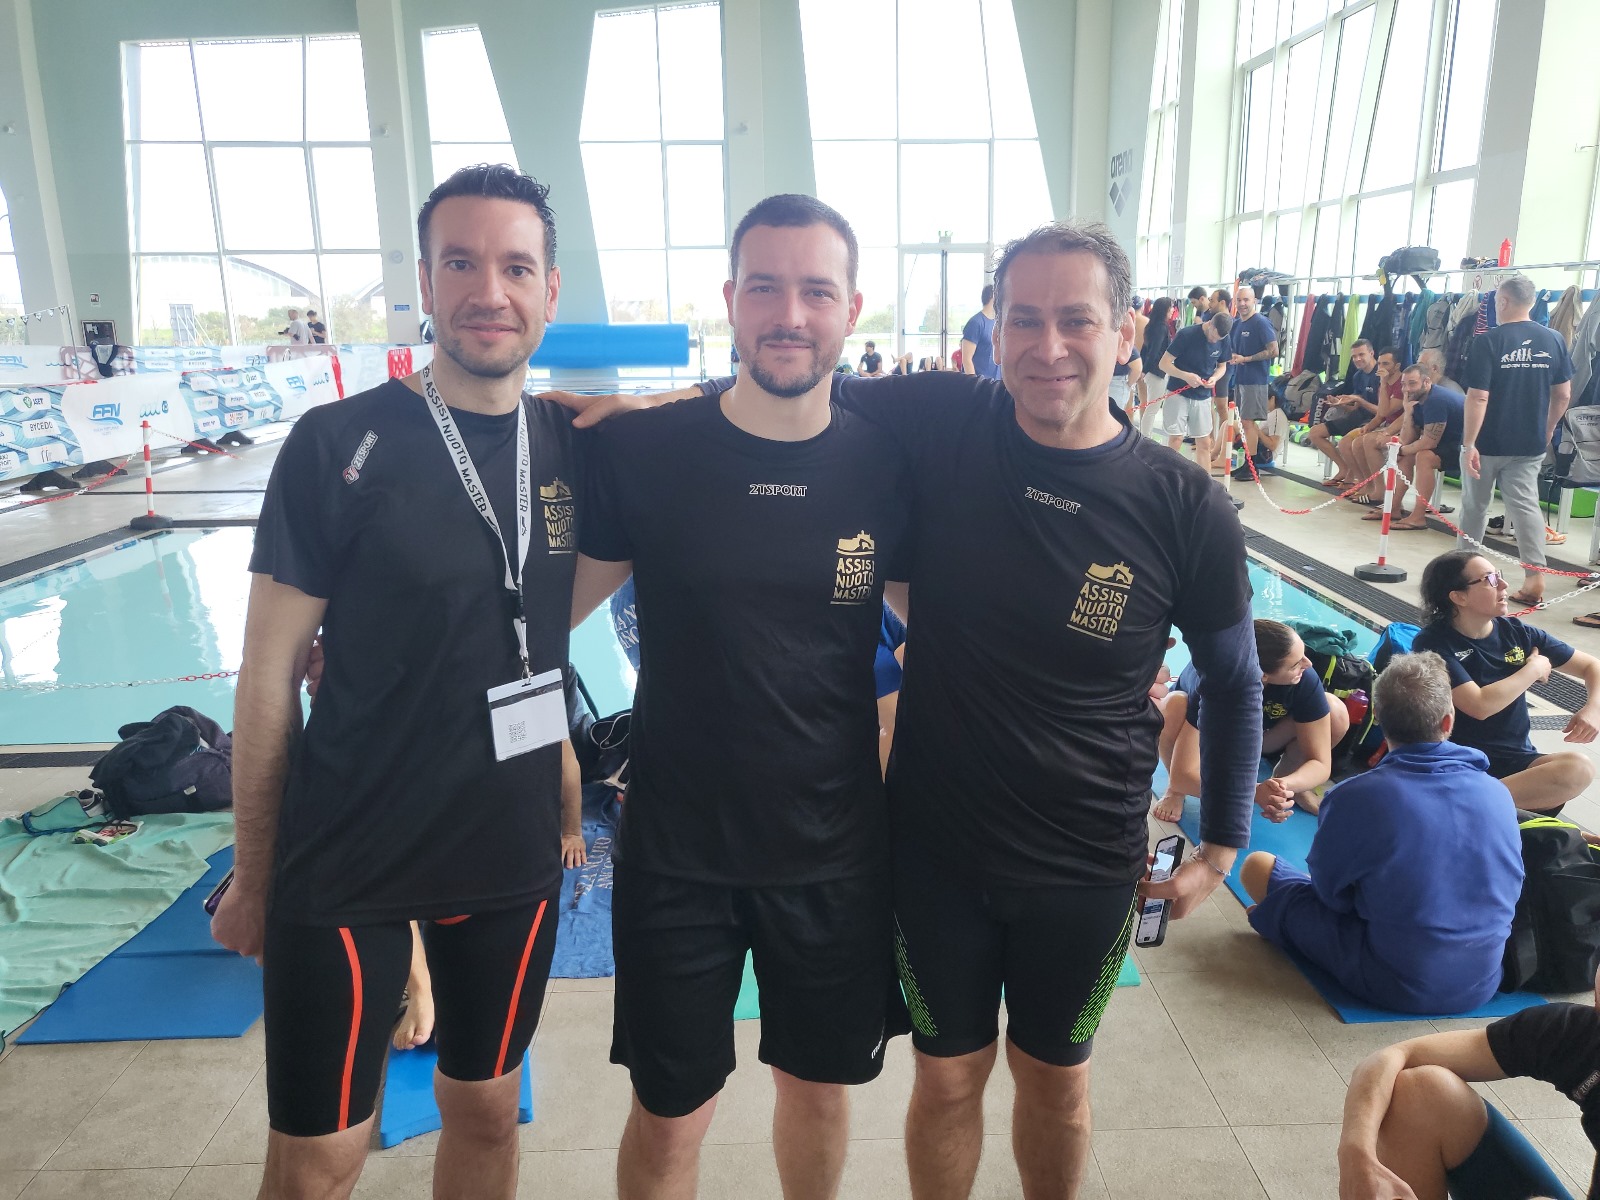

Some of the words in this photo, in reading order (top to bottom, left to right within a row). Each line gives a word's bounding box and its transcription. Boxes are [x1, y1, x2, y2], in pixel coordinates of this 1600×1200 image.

[1111, 148, 1133, 179] arena
[426, 381, 450, 421] ASSISI
[442, 424, 468, 465] NUOTO
[461, 467, 487, 513] MASTER
[519, 427, 529, 467] NUOTO
[519, 469, 529, 512] MASTER
[749, 483, 807, 497] 2TSPORT
[1024, 486, 1081, 515] 2TSPORT
[548, 531, 576, 548] MASTE
[836, 557, 875, 574] ASSISI
[835, 570, 874, 589] NUOTO
[1080, 581, 1128, 608] ASSISI
[1074, 596, 1123, 621] NUOTO
[1069, 610, 1118, 636] MASTER
